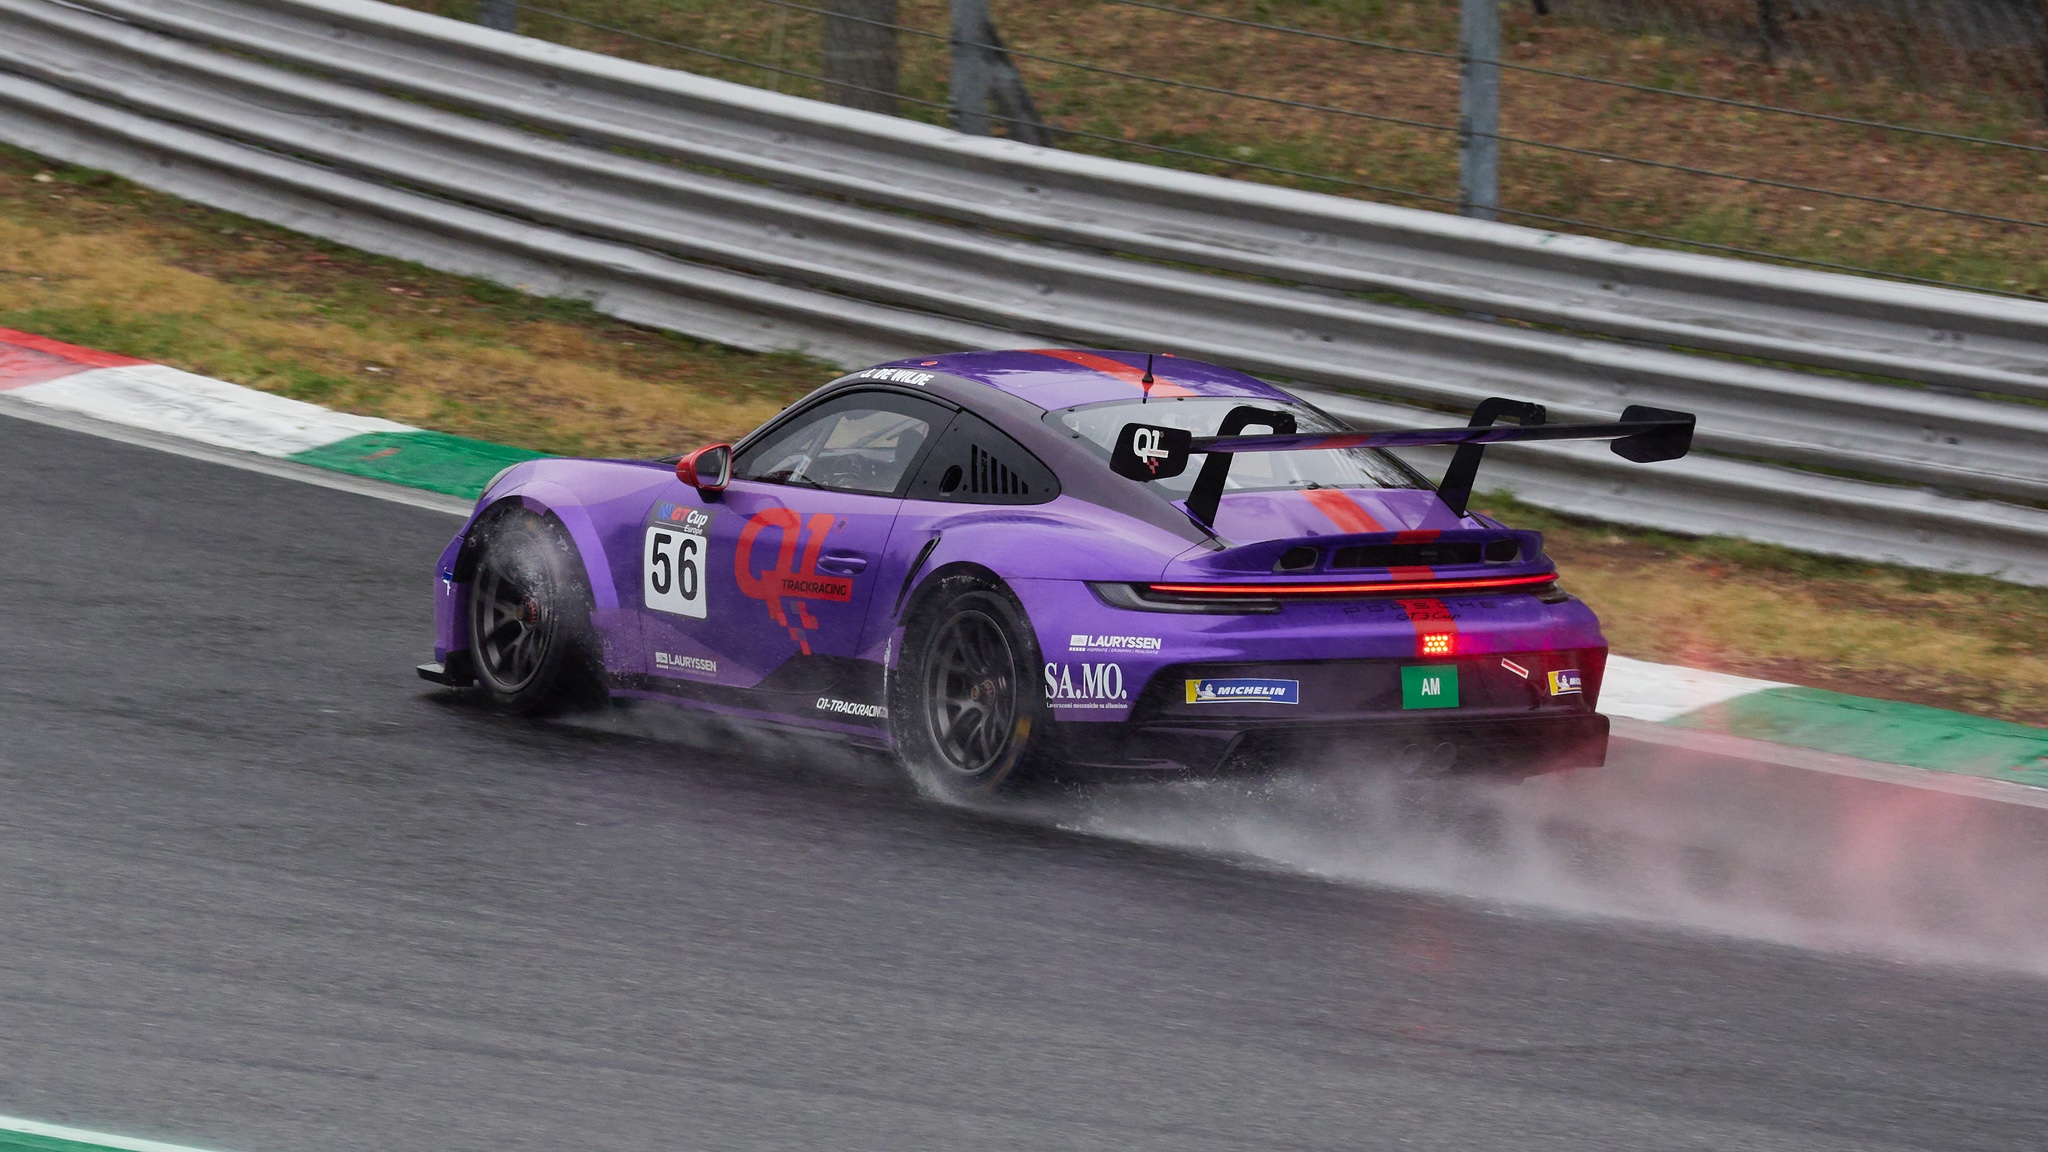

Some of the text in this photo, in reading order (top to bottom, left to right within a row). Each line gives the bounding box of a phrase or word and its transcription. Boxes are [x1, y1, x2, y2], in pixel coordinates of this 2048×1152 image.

[860, 368, 935, 387] J. DE WILDE
[671, 506, 708, 528] GT Cup
[683, 524, 703, 536] Europe
[651, 532, 698, 601] 56
[782, 578, 848, 596] TRACKRACING
[1342, 601, 1498, 615] PORSCHE
[1087, 635, 1162, 650] LAURYSSEN
[668, 653, 717, 673] LAURYSSEN
[1044, 662, 1128, 700] SA.MO.
[1421, 677, 1440, 696] AM
[1217, 686, 1286, 696] MICHELIN
